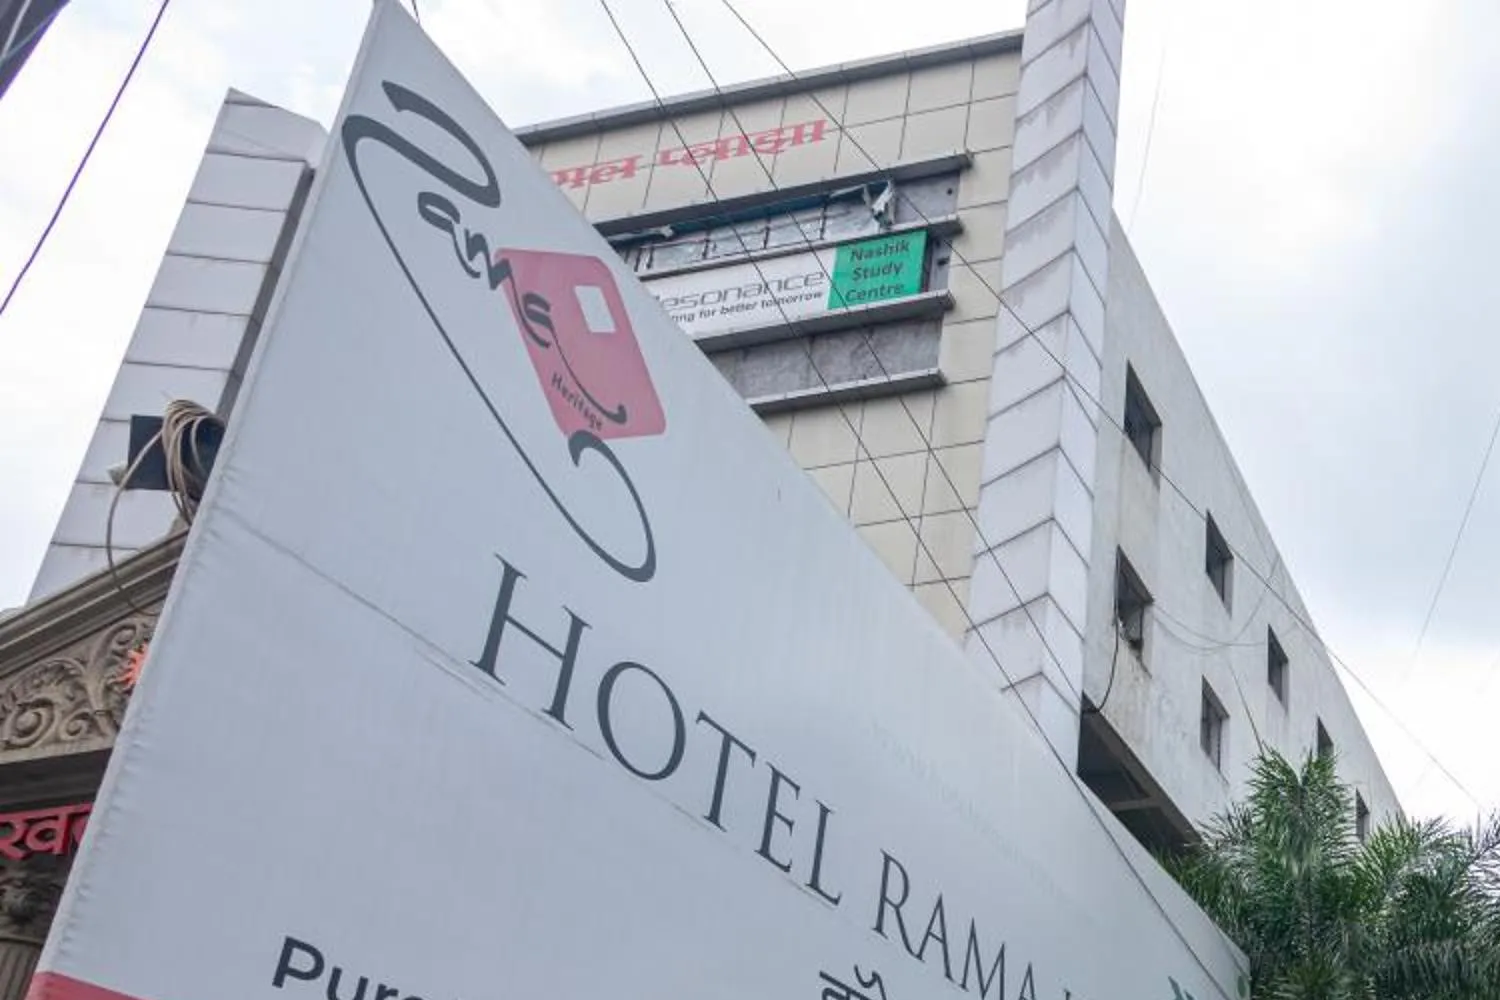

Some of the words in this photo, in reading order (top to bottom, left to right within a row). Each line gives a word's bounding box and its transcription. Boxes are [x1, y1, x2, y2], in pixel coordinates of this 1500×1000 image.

[850, 239, 910, 261] Nashik
[851, 261, 902, 284] Study
[655, 270, 825, 312] esonance
[844, 282, 906, 301] Centre
[699, 307, 716, 319] for
[720, 301, 758, 316] better
[761, 290, 823, 310] tomorrow
[470, 553, 842, 906] HOTEL
